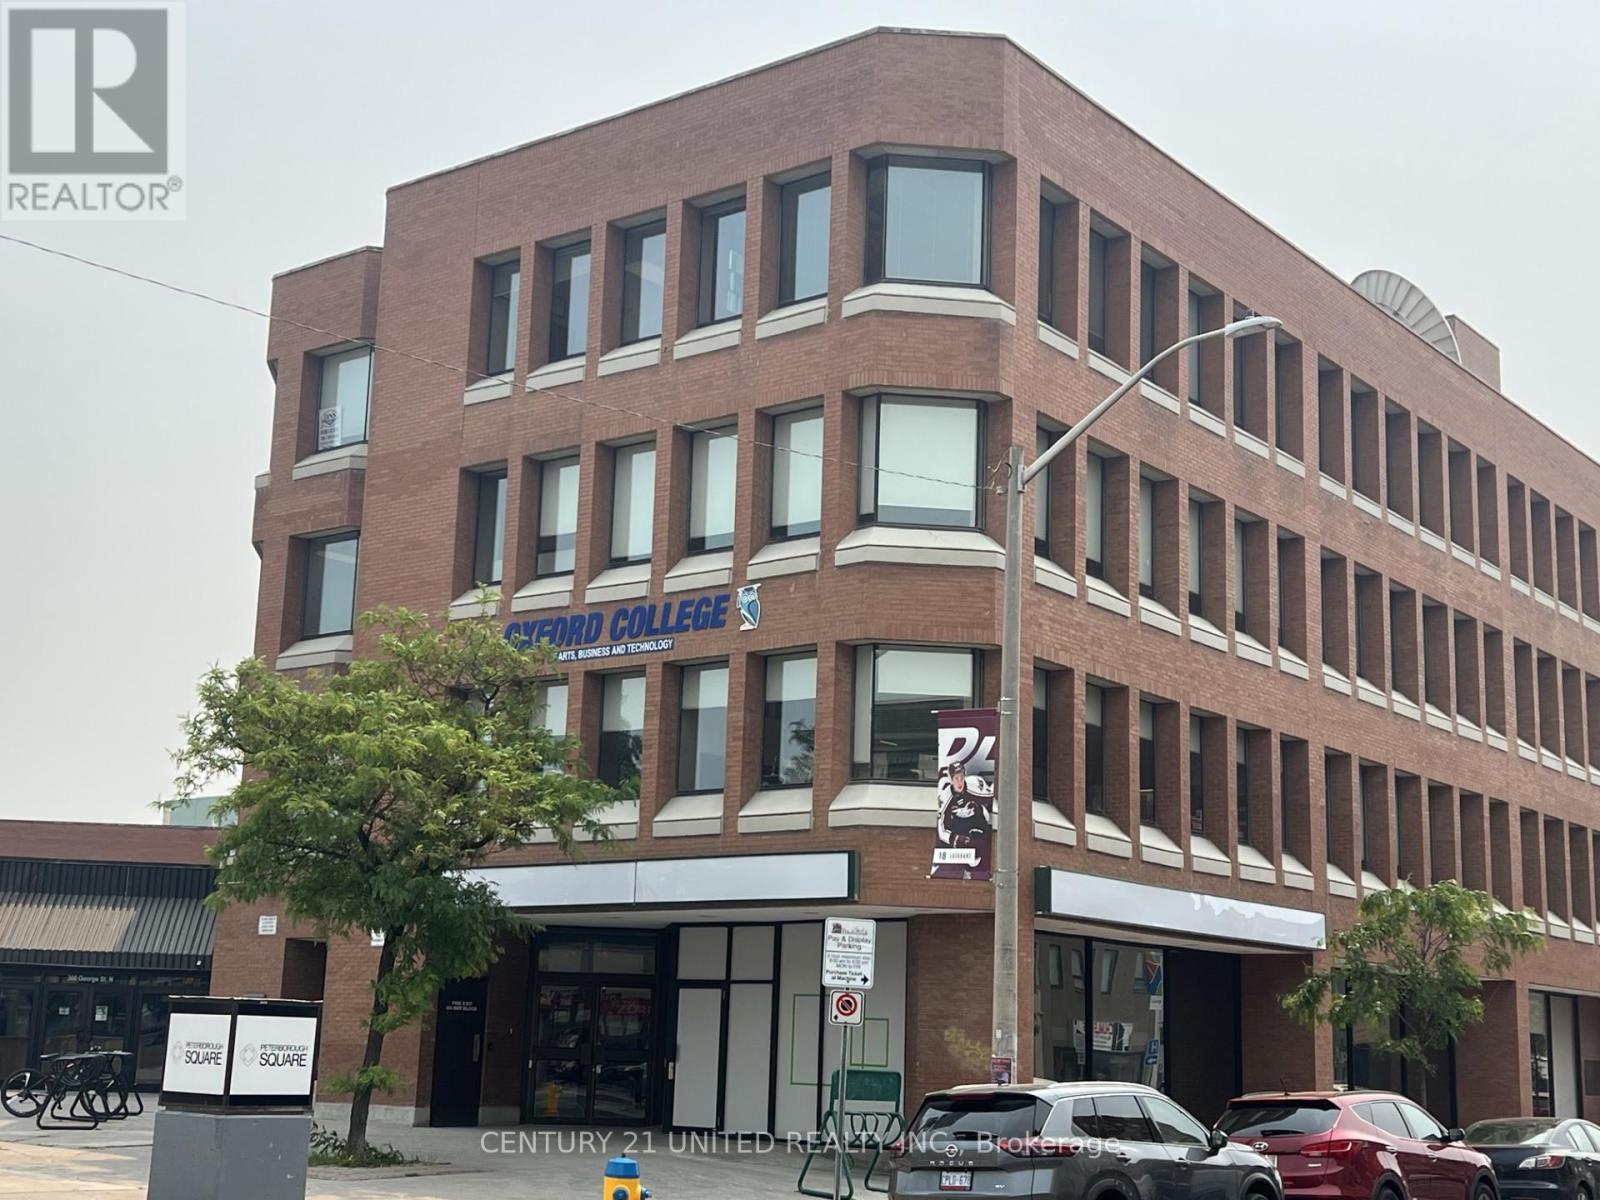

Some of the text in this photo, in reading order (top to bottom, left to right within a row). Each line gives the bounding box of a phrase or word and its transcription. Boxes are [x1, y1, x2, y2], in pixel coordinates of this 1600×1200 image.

[504, 594, 730, 650] OXFORD COLLEGE
[559, 651, 577, 661] ARTS,
[578, 646, 610, 660] BUSINESS
[611, 644, 626, 655] AND
[626, 639, 673, 653] TECHNOLOGY
[79, 975, 99, 983] George
[186, 1041, 224, 1049] PETERBOROUGH
[260, 1043, 308, 1051] PETERBOROUGH
[185, 1050, 222, 1065] SQUARE
[259, 1052, 307, 1067] SQUARE
